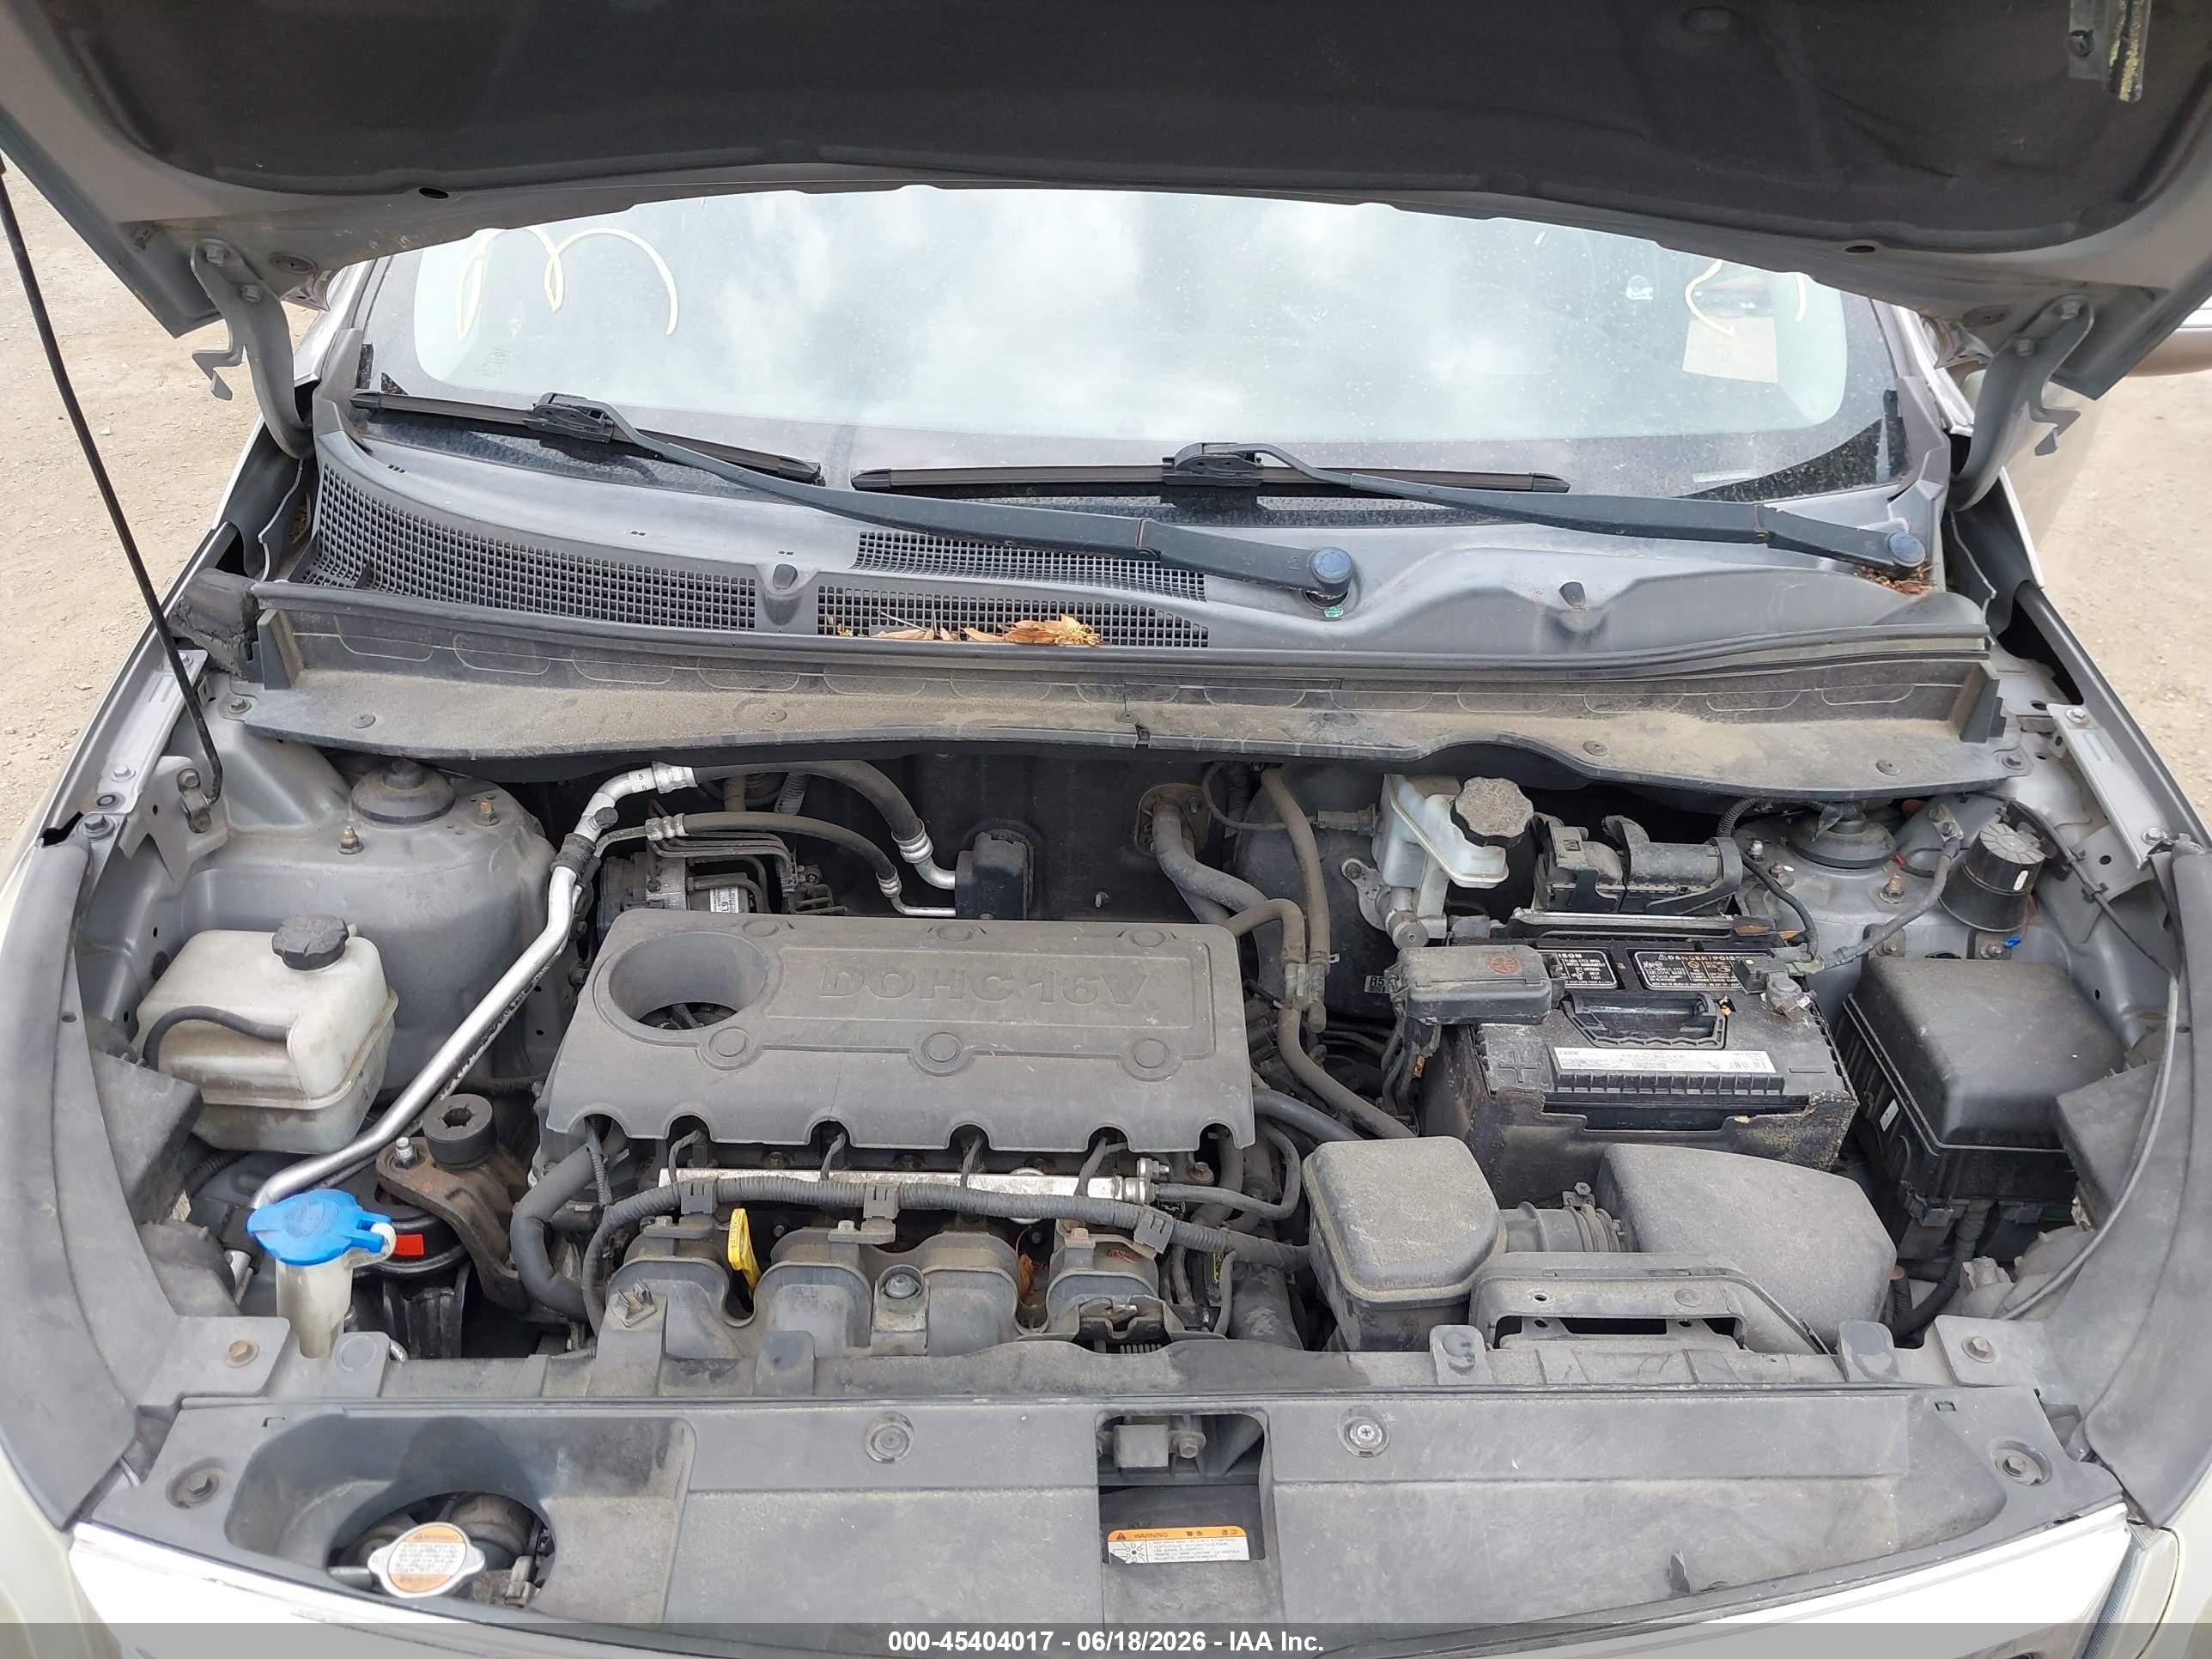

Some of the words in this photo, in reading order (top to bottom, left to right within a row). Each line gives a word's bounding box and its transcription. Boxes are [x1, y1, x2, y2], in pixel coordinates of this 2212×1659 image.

[820, 967, 1017, 1002] DOHC
[1030, 968, 1149, 1006] 16V
[1133, 1531, 1169, 1540] WARNING
